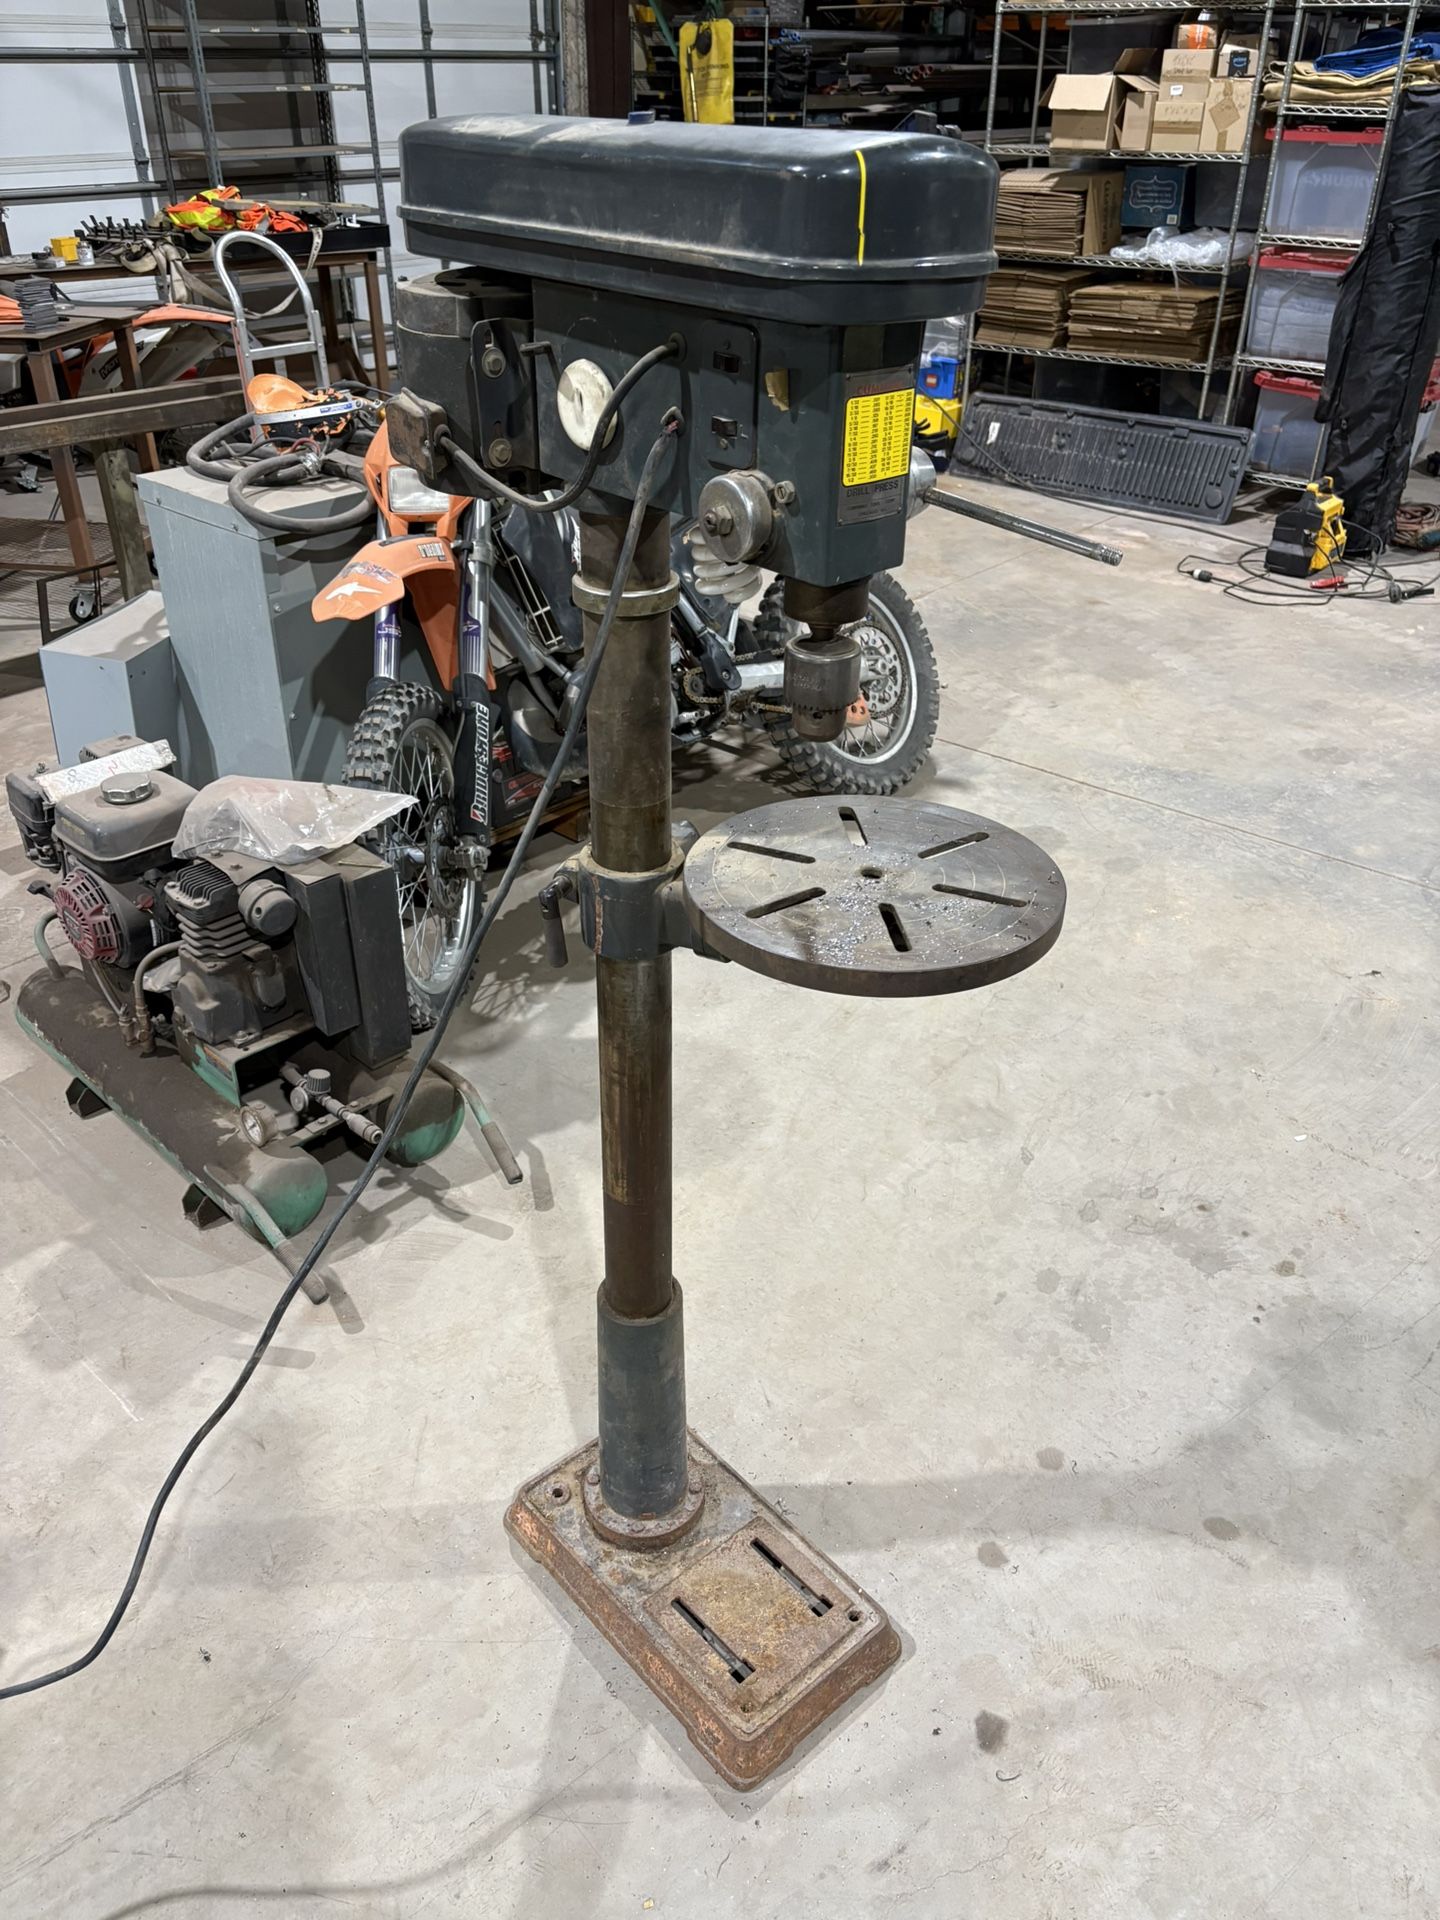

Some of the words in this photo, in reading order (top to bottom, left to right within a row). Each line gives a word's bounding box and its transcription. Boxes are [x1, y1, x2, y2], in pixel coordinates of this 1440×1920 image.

[847, 488, 870, 498] DRILL
[875, 481, 898, 493] PRESS
[470, 702, 489, 825] BRIDGESTONE
